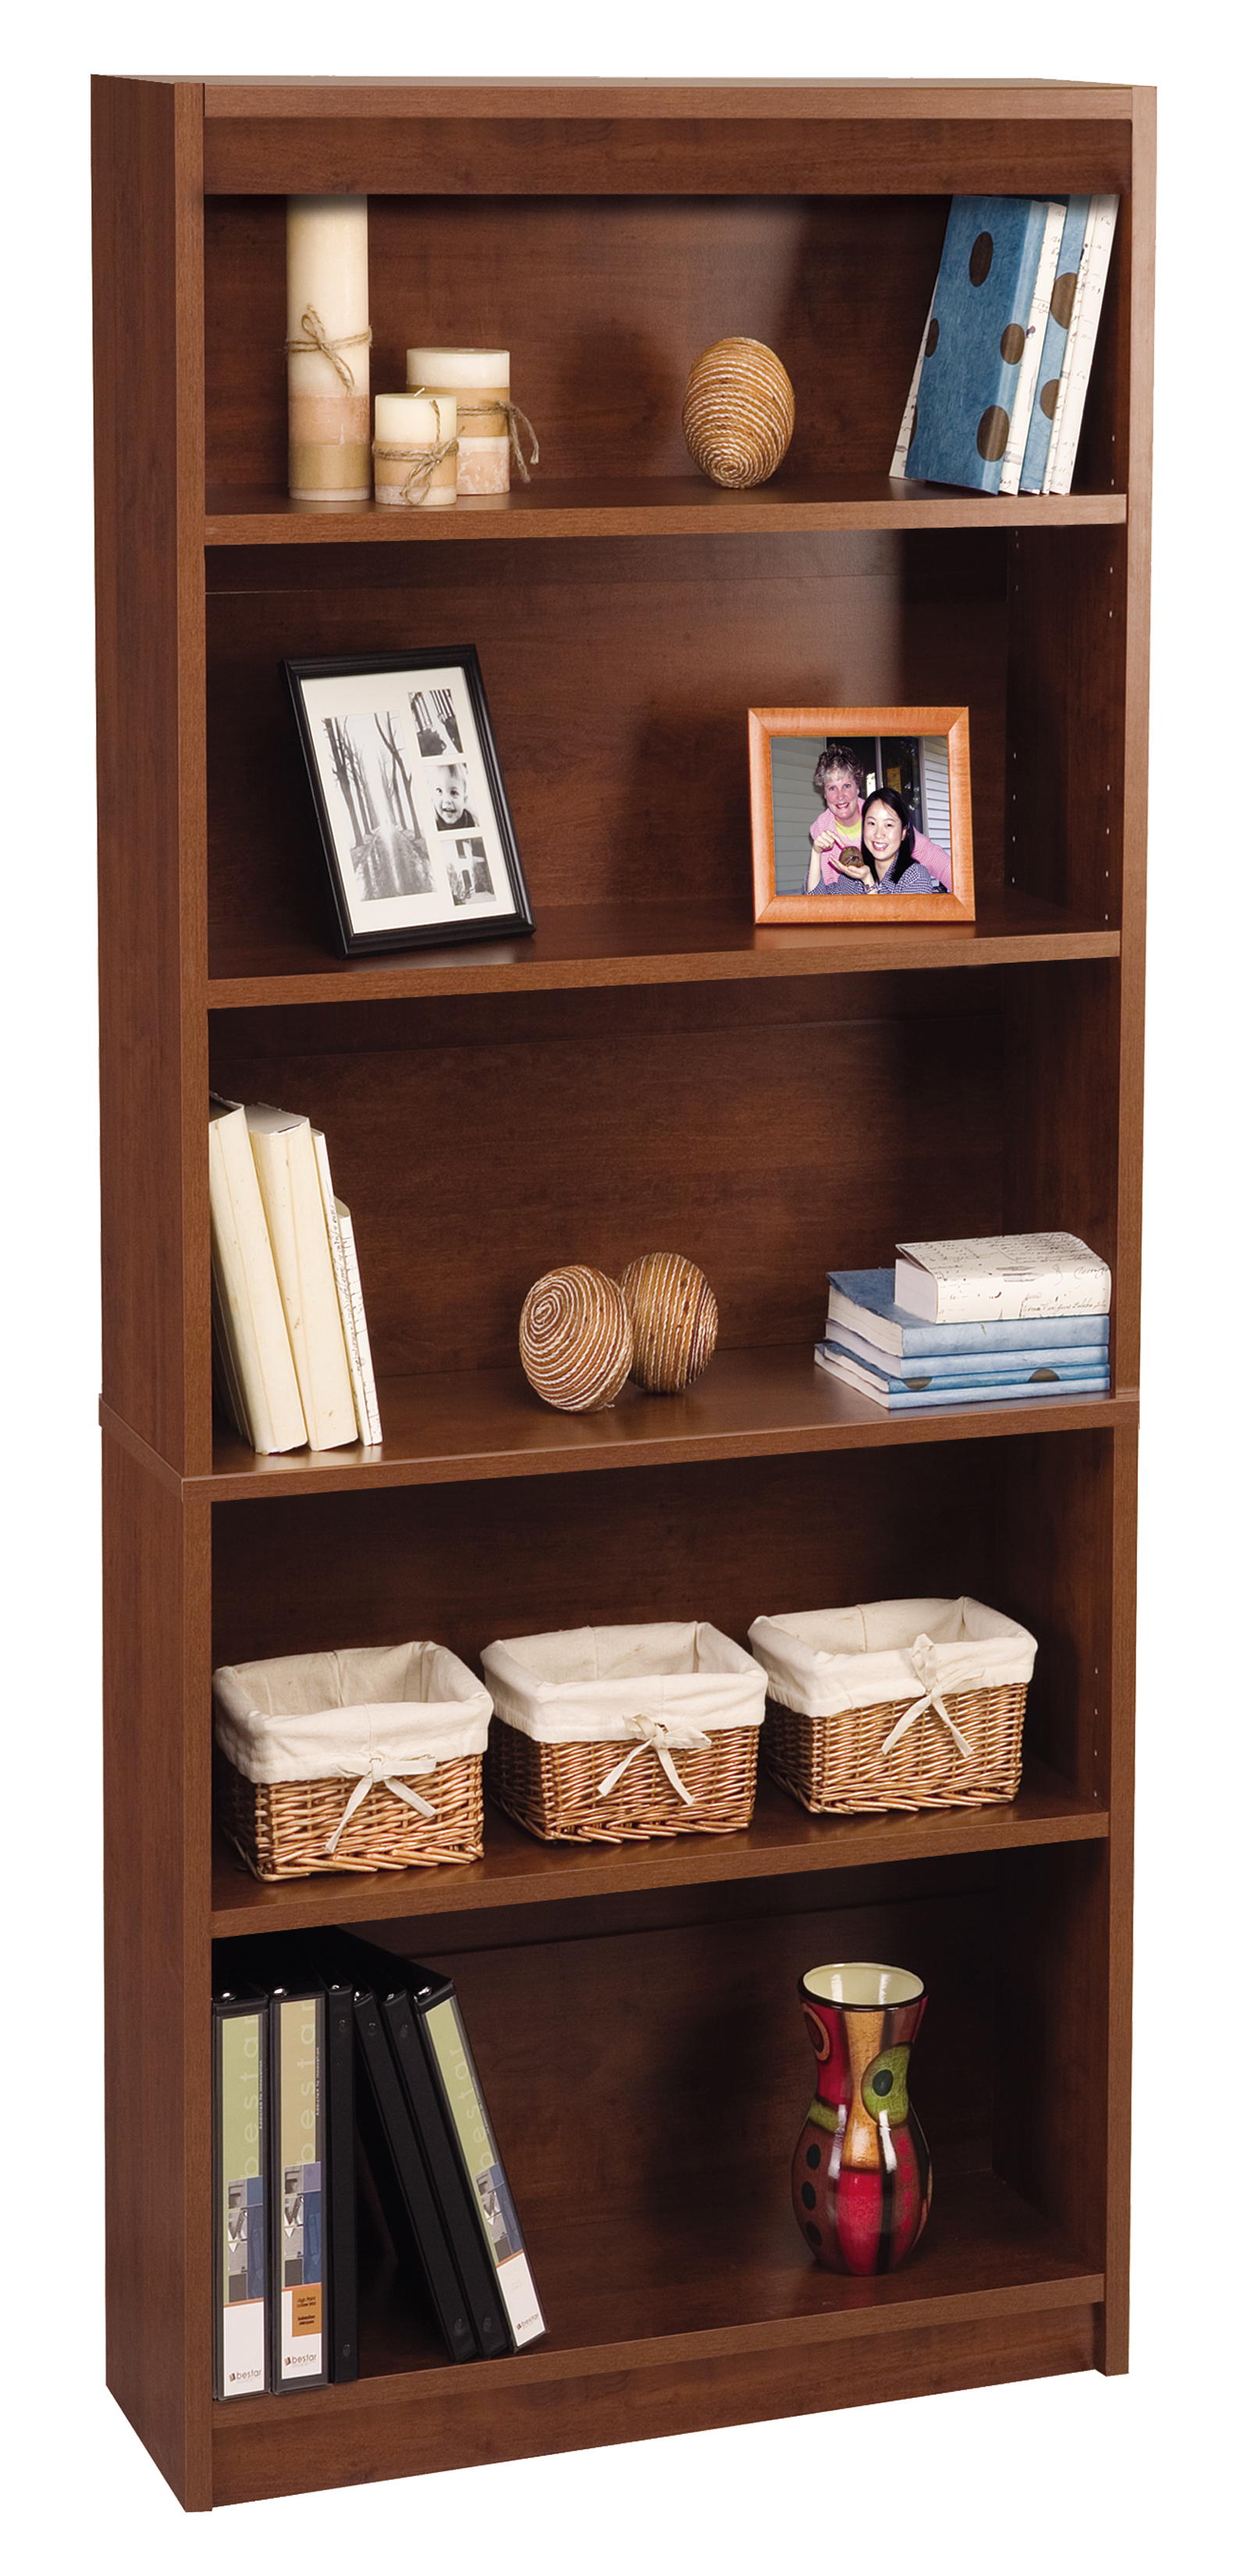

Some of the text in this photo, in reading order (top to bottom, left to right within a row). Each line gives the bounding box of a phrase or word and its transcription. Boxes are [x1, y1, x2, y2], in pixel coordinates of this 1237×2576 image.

[240, 2016, 258, 2178] bestar
[297, 2001, 315, 2165] bestar
[450, 2047, 495, 2172] bestar
[521, 2313, 539, 2327] bestar
[236, 2369, 261, 2379] bestar
[292, 2354, 317, 2364] bestar
